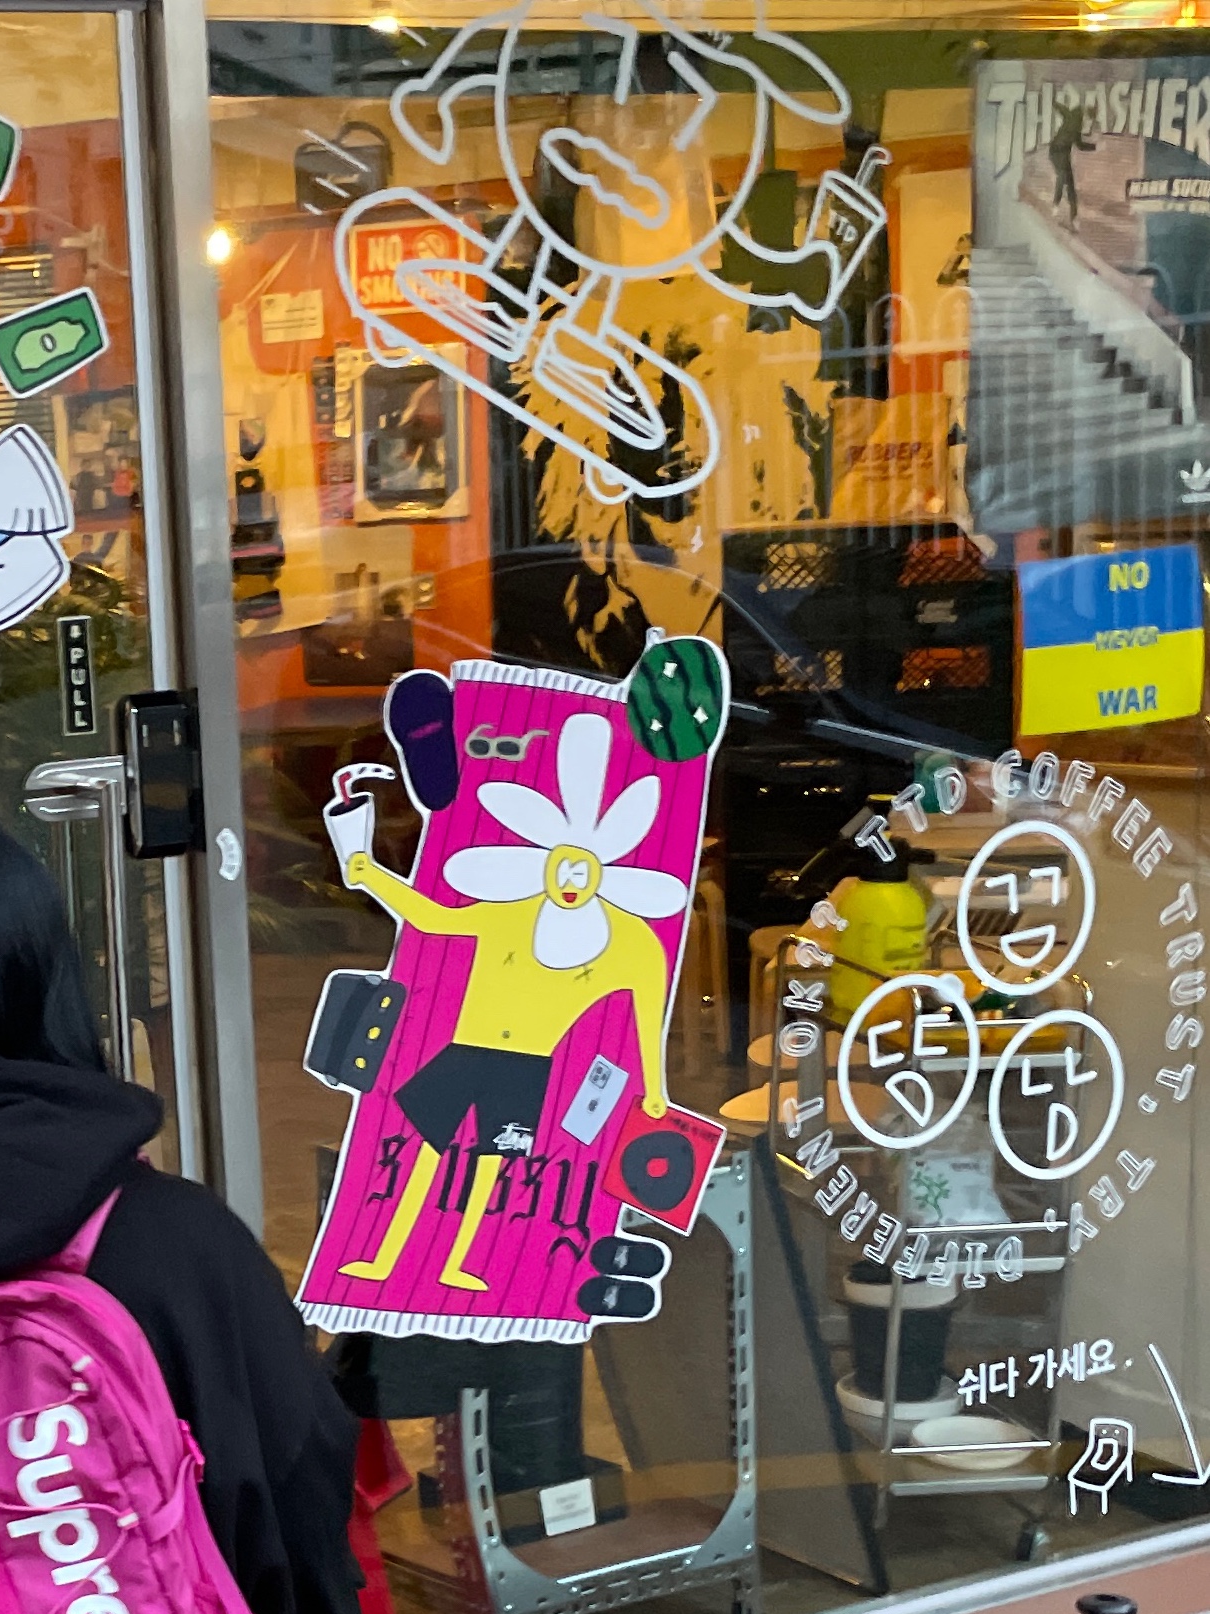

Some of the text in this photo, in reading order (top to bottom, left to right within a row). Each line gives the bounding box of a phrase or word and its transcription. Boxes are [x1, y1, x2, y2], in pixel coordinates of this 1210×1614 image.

[367, 233, 404, 272] NO
[1108, 561, 1150, 592] NO
[69, 647, 90, 728] PULL
[1098, 685, 1159, 717] WAR
[854, 765, 968, 863] TTD
[991, 748, 1174, 879] COFFEE
[783, 1096, 1024, 1290] DIFFERENT
[957, 1355, 1020, 1406] 쉬다
